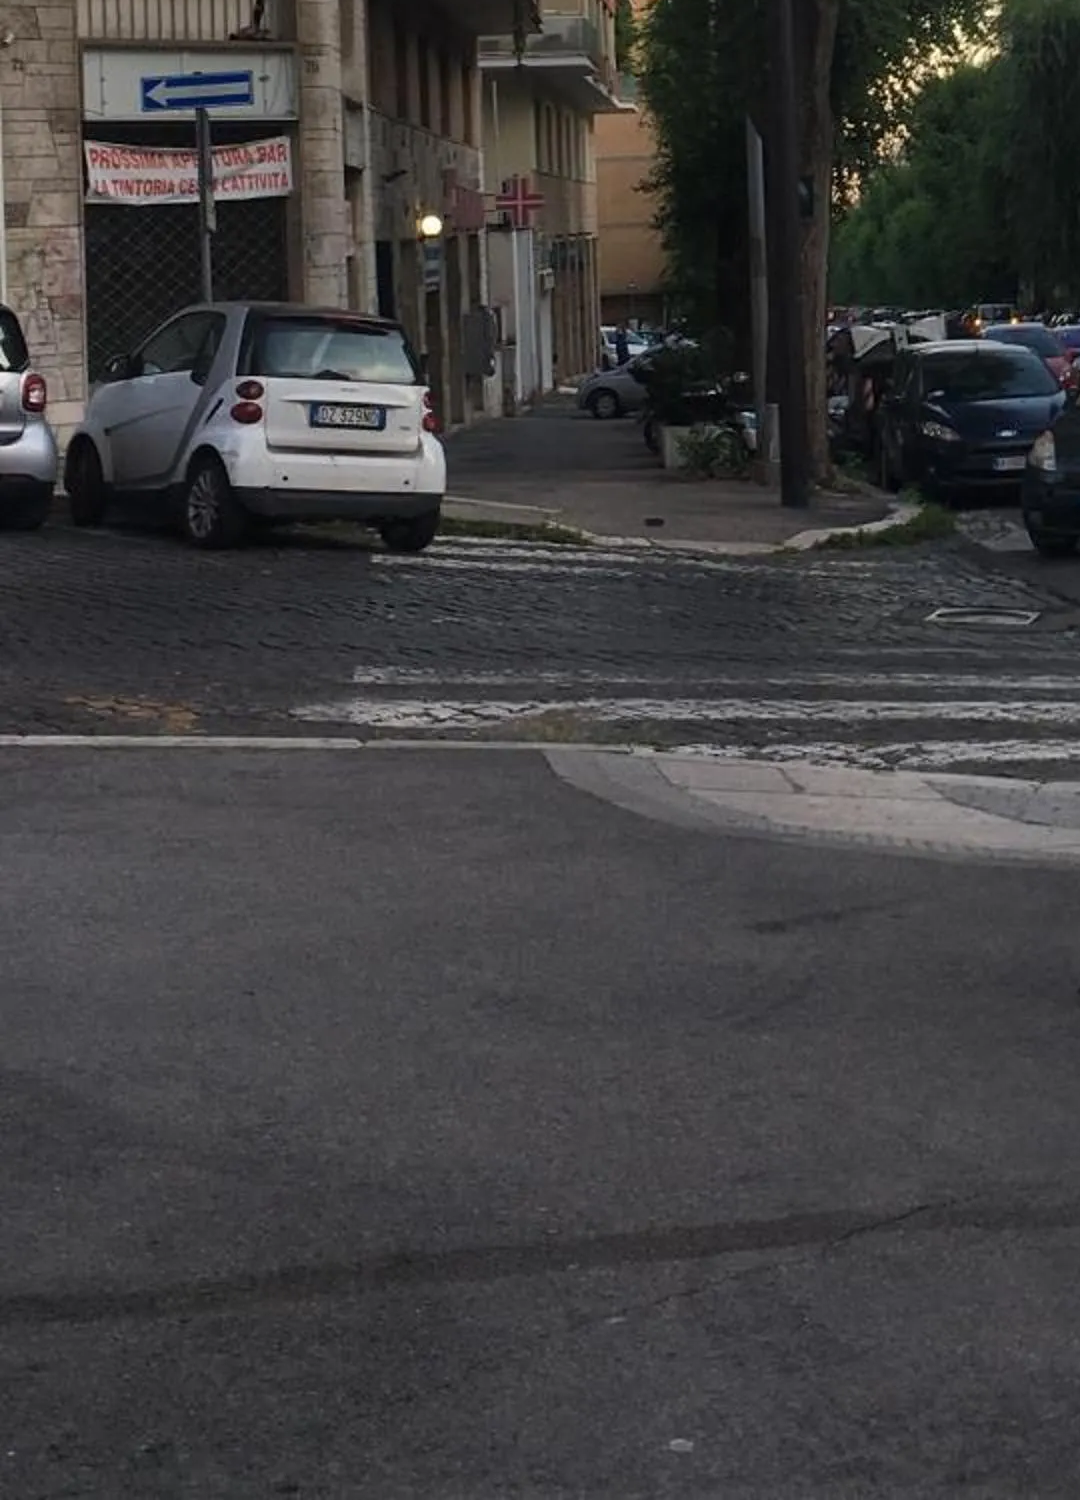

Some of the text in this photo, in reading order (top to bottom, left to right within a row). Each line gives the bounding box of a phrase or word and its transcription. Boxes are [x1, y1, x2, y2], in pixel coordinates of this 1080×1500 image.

[89, 143, 287, 170] PROSSIMA APETURA BAR
[112, 178, 174, 196] TINTORIA
